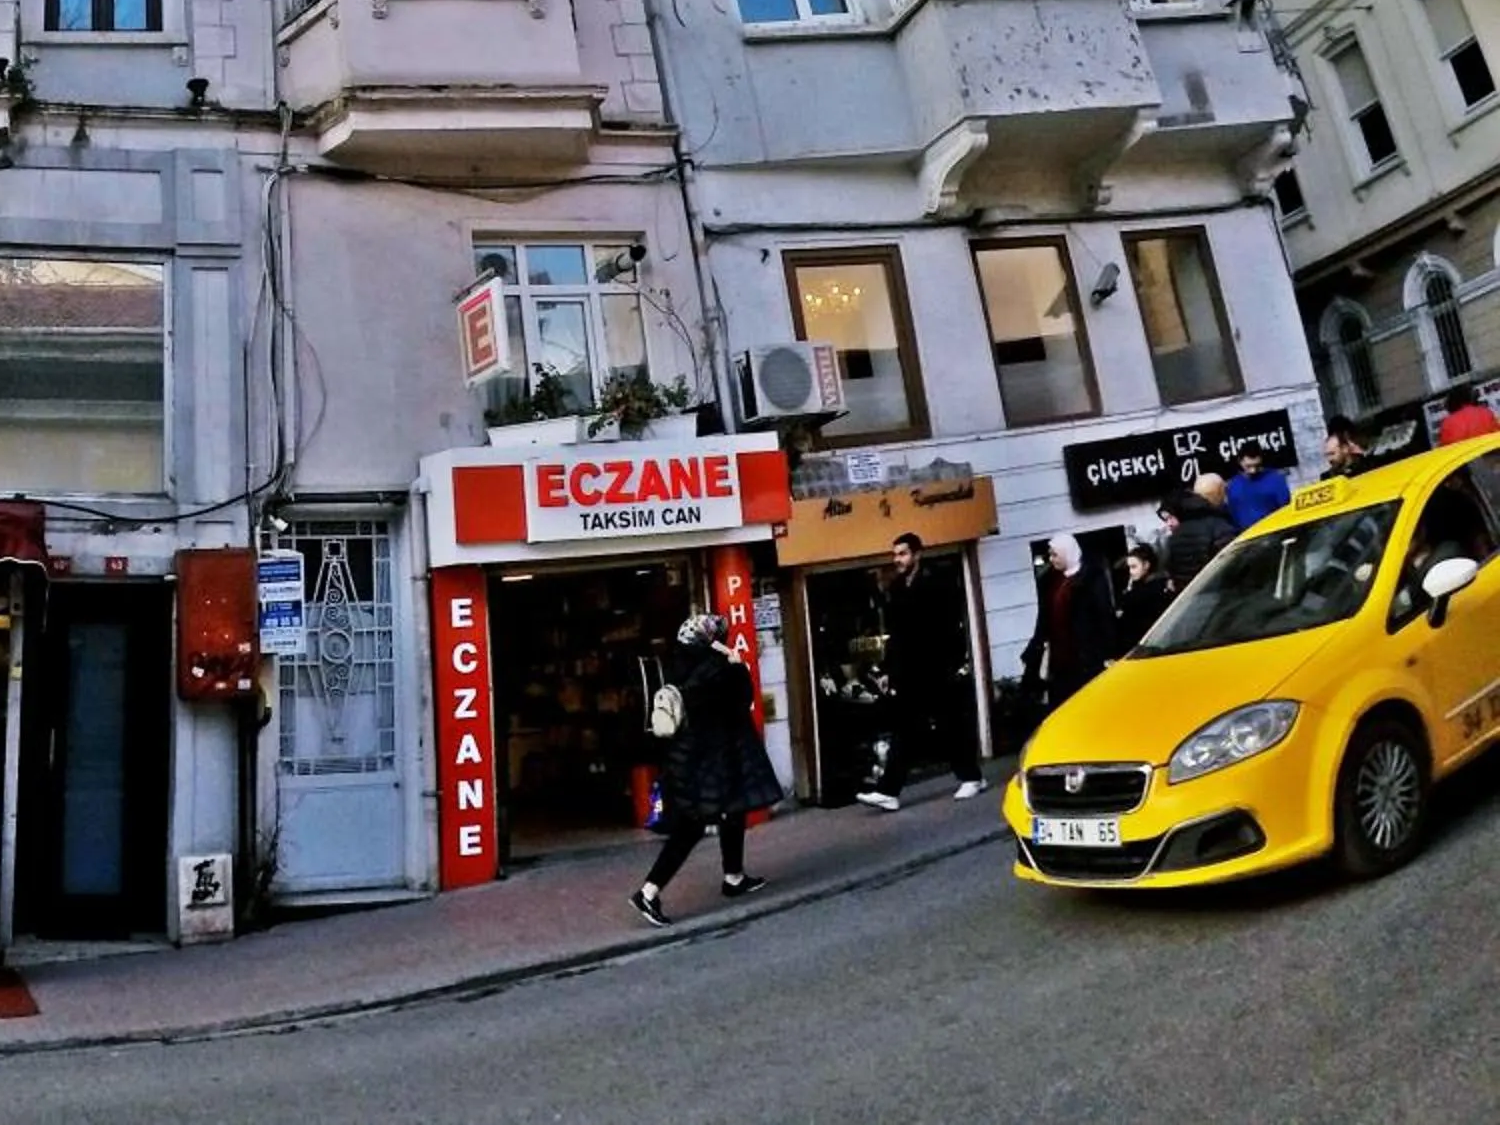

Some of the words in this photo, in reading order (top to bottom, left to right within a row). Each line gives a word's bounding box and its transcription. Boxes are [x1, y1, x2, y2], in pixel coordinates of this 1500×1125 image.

[468, 297, 493, 367] E
[1173, 430, 1206, 456] ER
[536, 455, 733, 508] ECZANE
[1087, 449, 1165, 486] ÇİÇEKÇİ
[579, 505, 655, 531] TAKSİM
[661, 506, 701, 525] CAN
[450, 597, 484, 856] ECZANE
